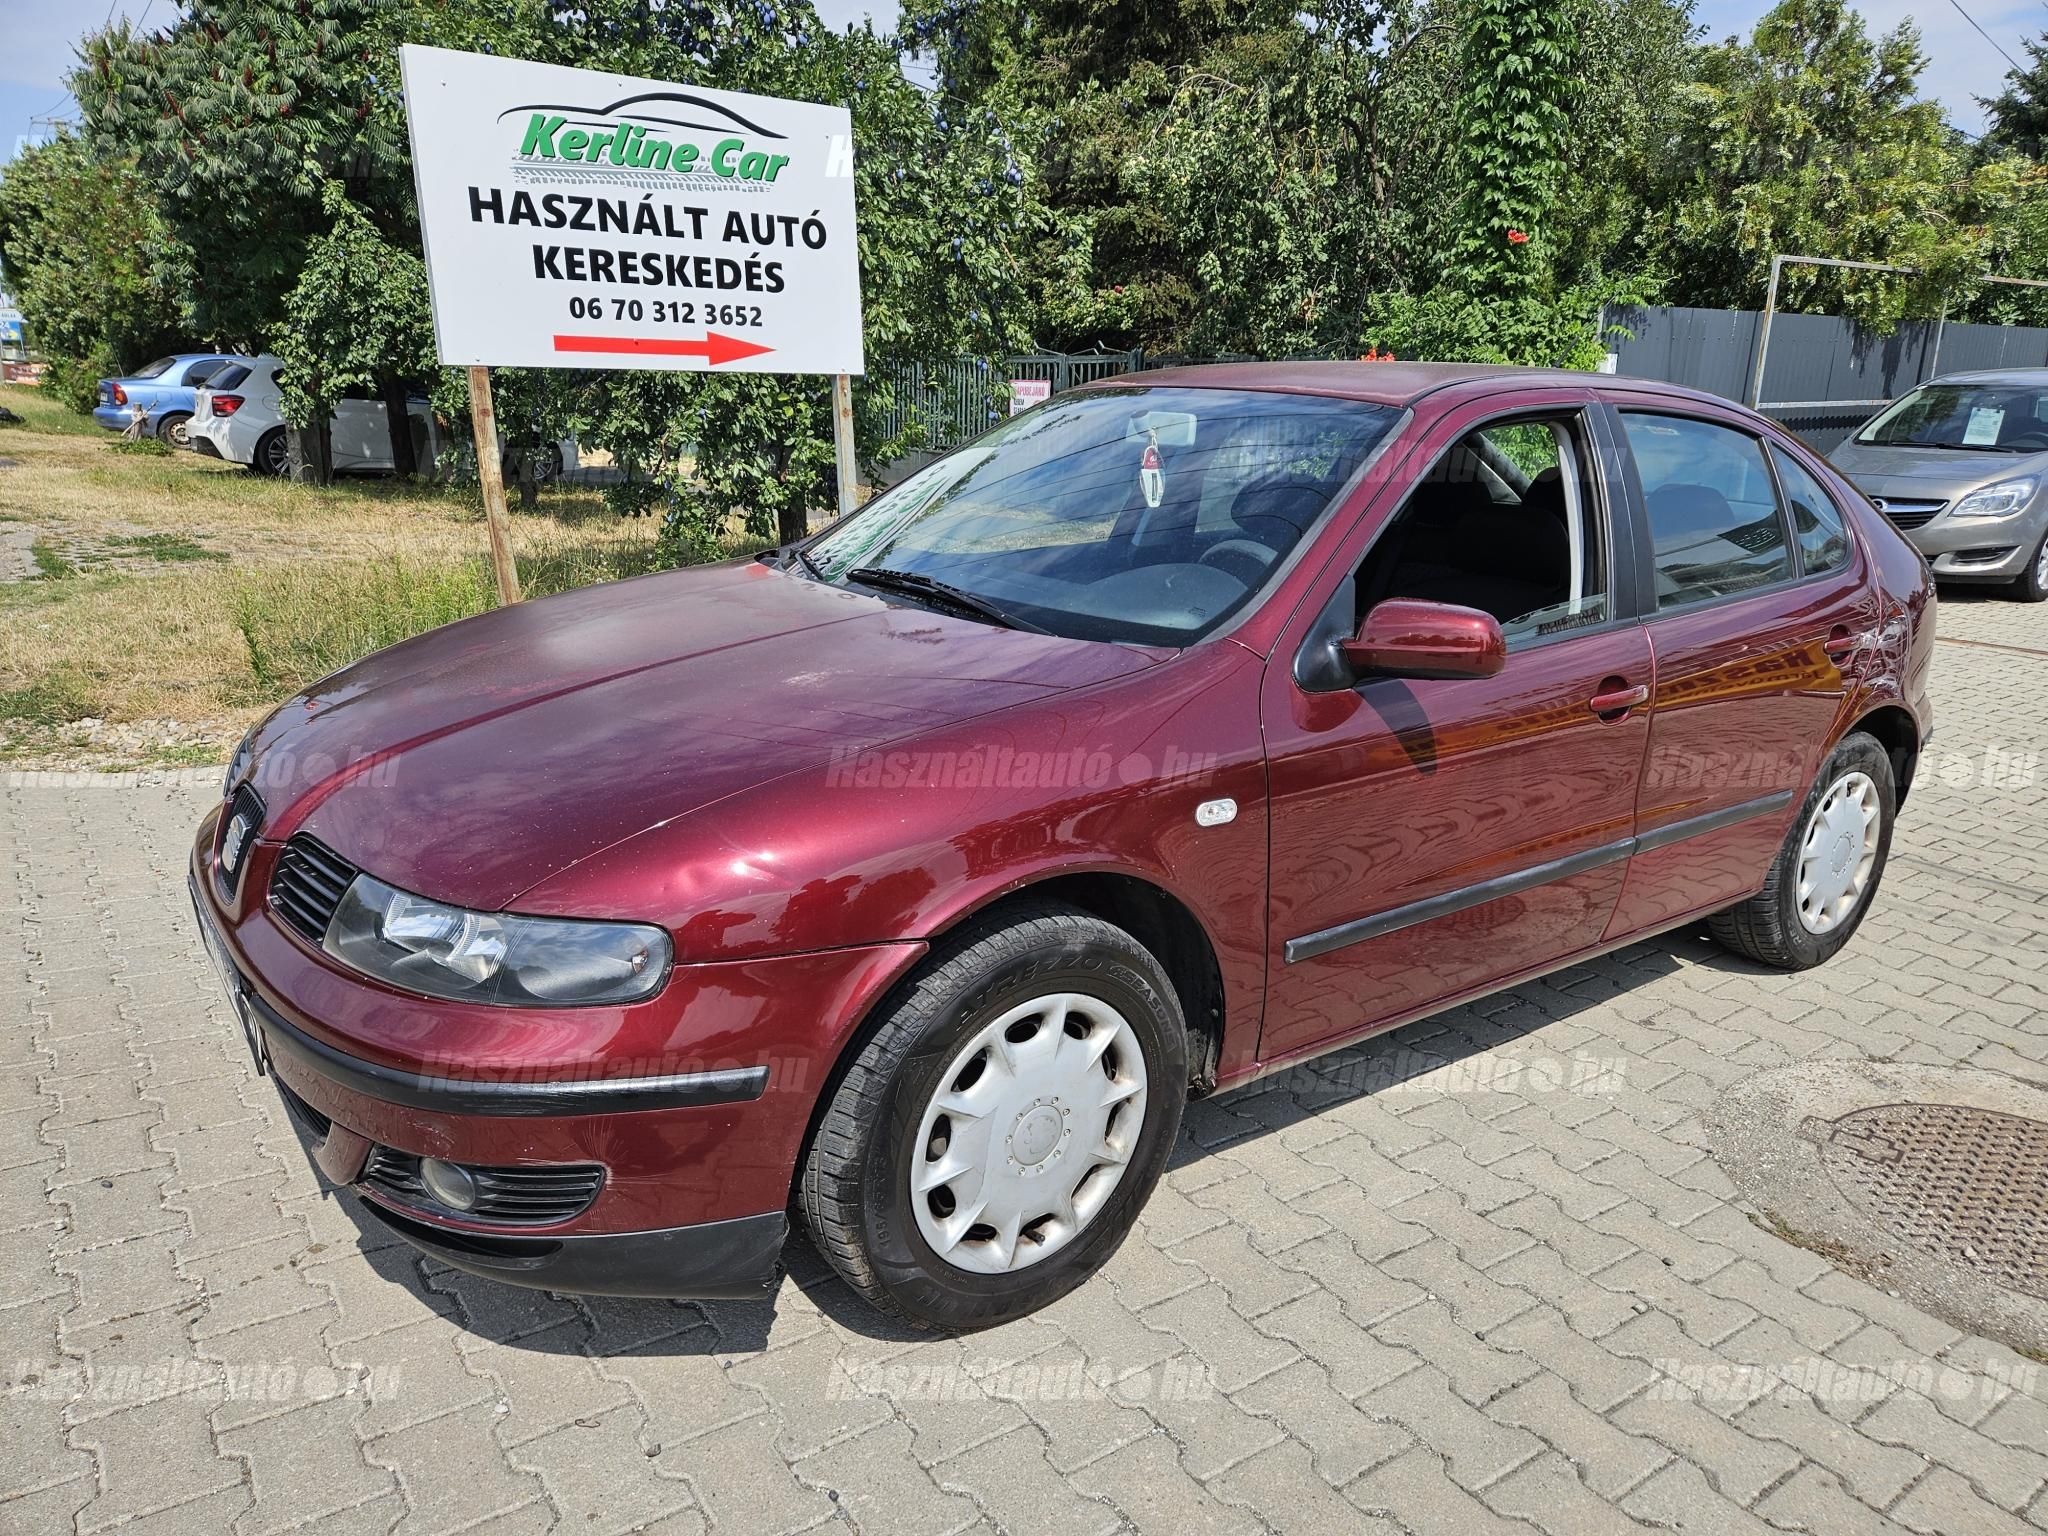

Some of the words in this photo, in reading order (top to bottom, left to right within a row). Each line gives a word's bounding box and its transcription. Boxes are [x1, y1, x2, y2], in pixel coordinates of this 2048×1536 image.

[519, 113, 700, 173] Kerline
[710, 138, 790, 182] Car
[468, 186, 708, 240] HASZNÁLT
[722, 209, 827, 250] AUTÓ
[532, 244, 785, 293] KERESKEDÉS
[569, 296, 603, 320] 06
[611, 299, 643, 321] 70
[652, 301, 696, 324] 312
[705, 303, 763, 327] 3652
